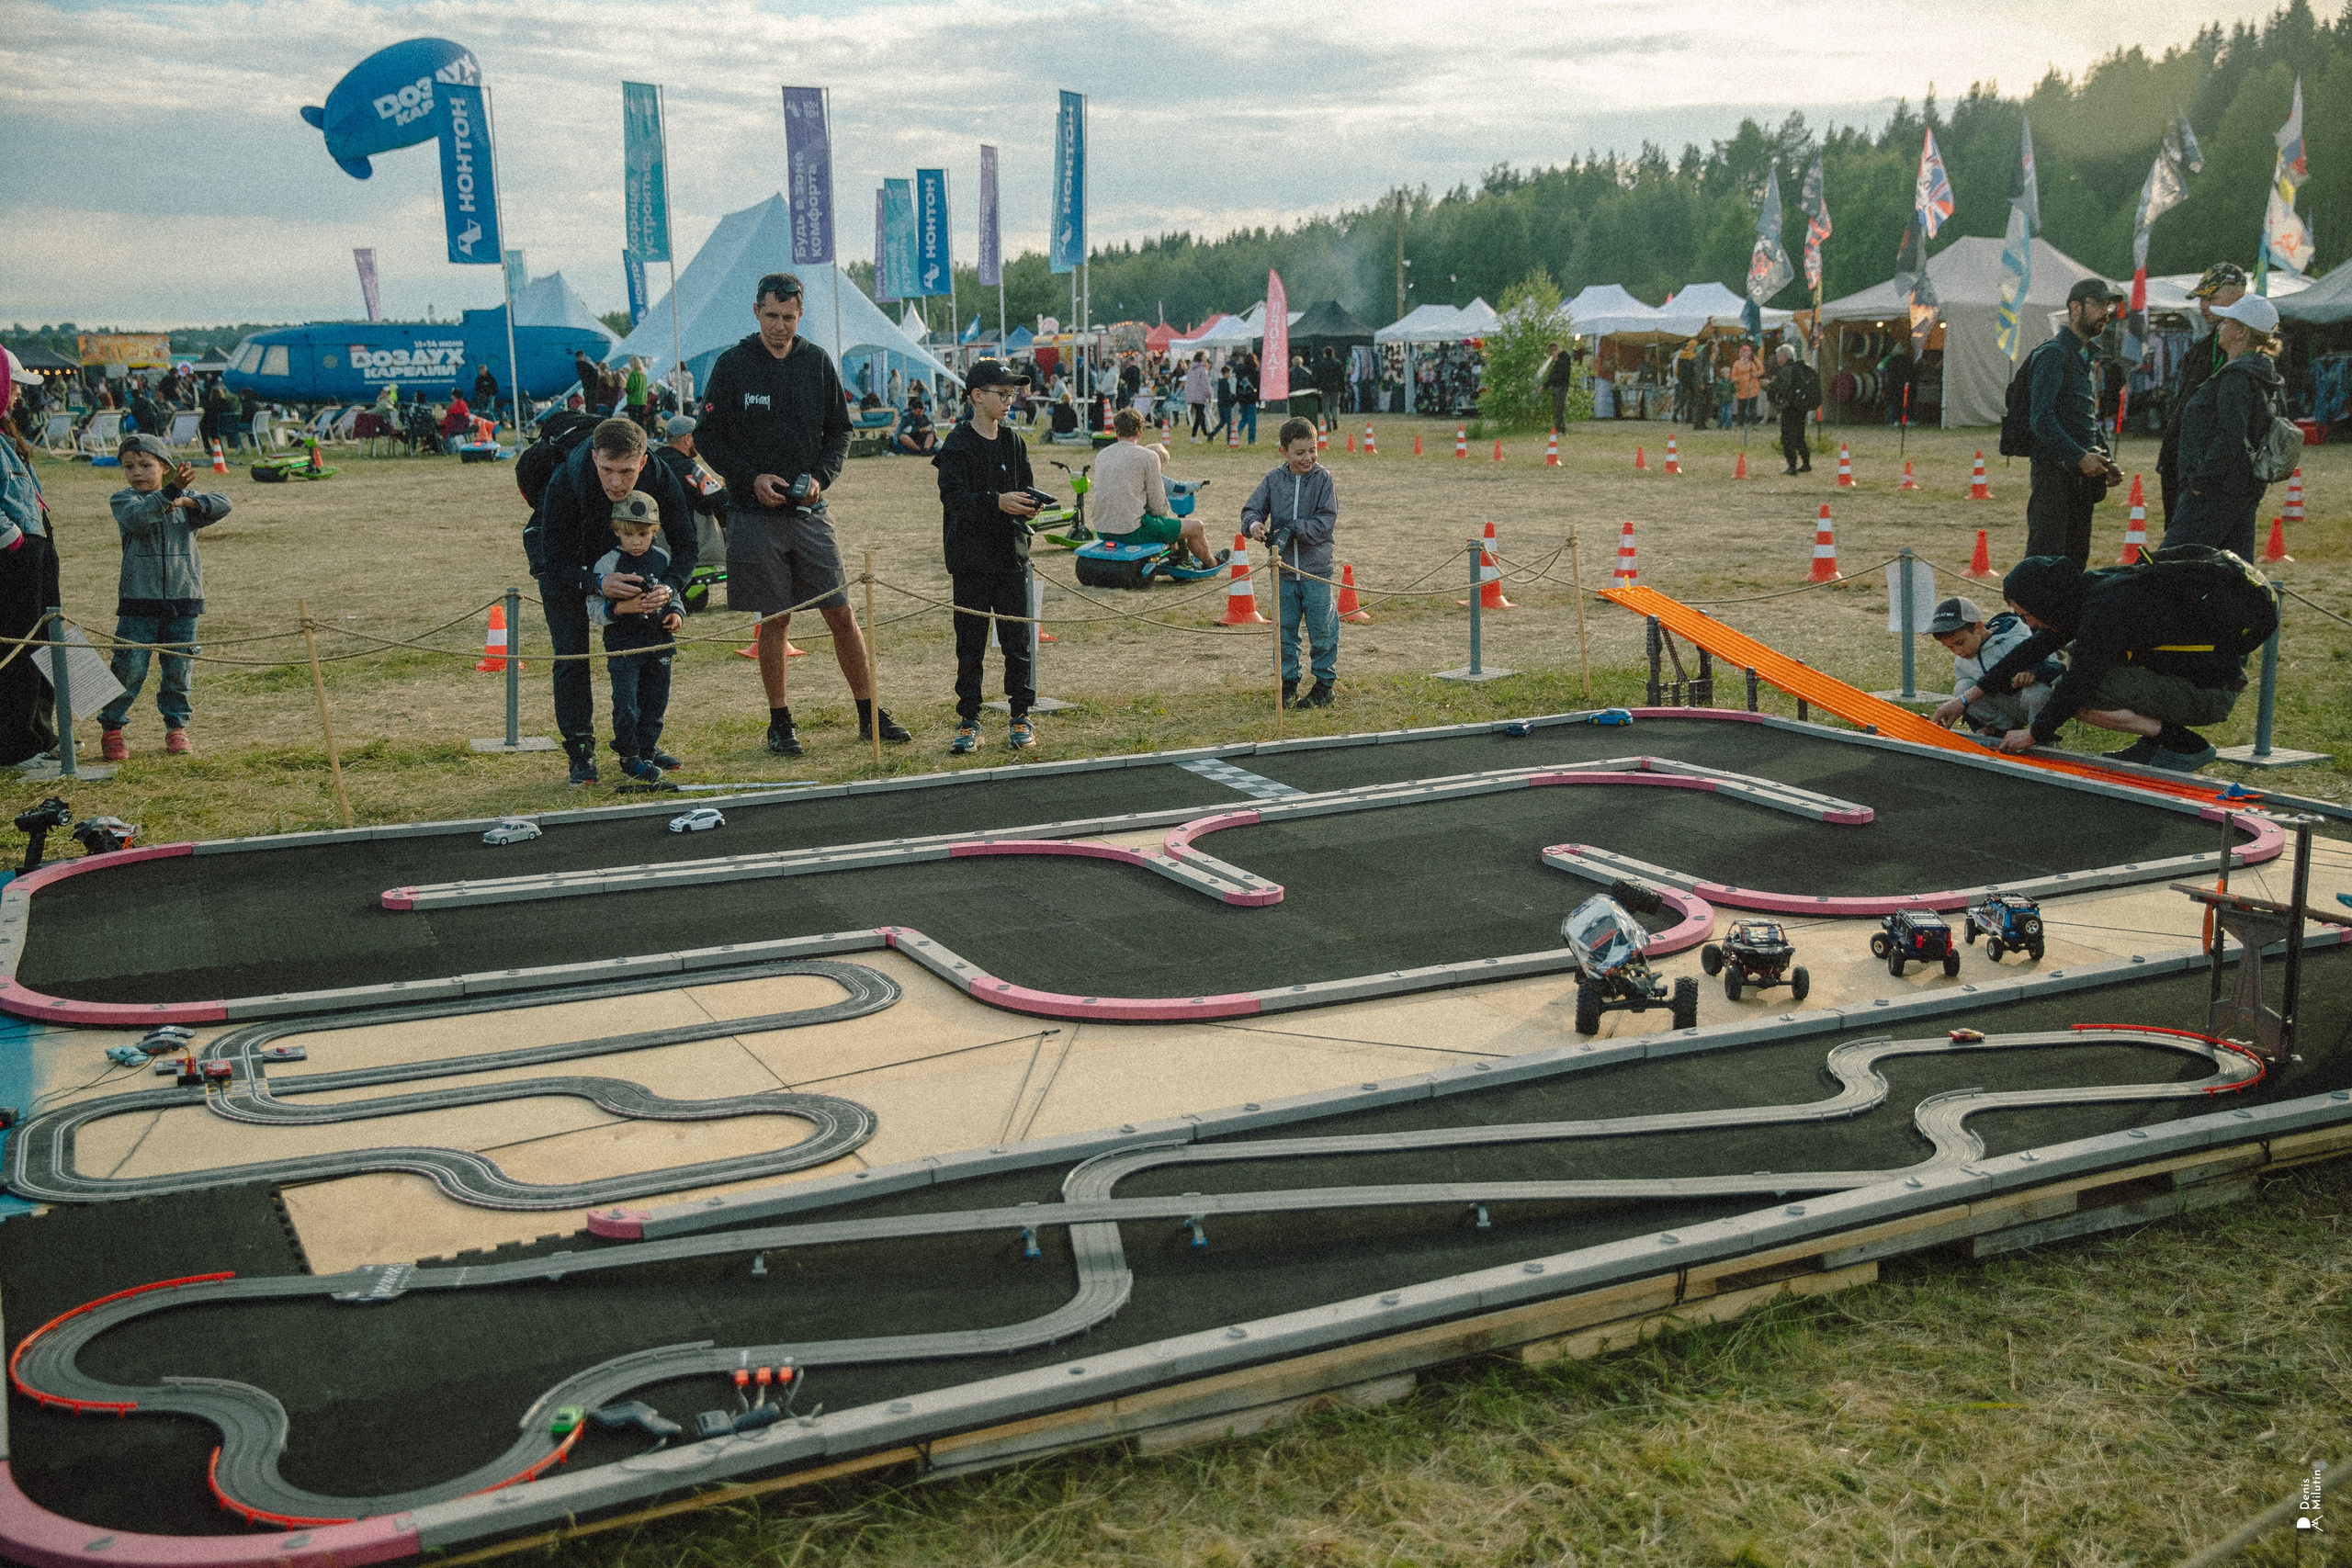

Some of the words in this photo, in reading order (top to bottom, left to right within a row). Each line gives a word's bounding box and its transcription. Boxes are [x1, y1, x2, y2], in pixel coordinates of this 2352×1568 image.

[449, 97, 476, 212] НОНТОН
[1063, 105, 1075, 215] НОНТОН
[795, 215, 808, 258] Будь
[806, 164, 823, 258] комфорта
[925, 178, 937, 259] НОНТОН
[351, 348, 465, 368] ВОЗДУХ
